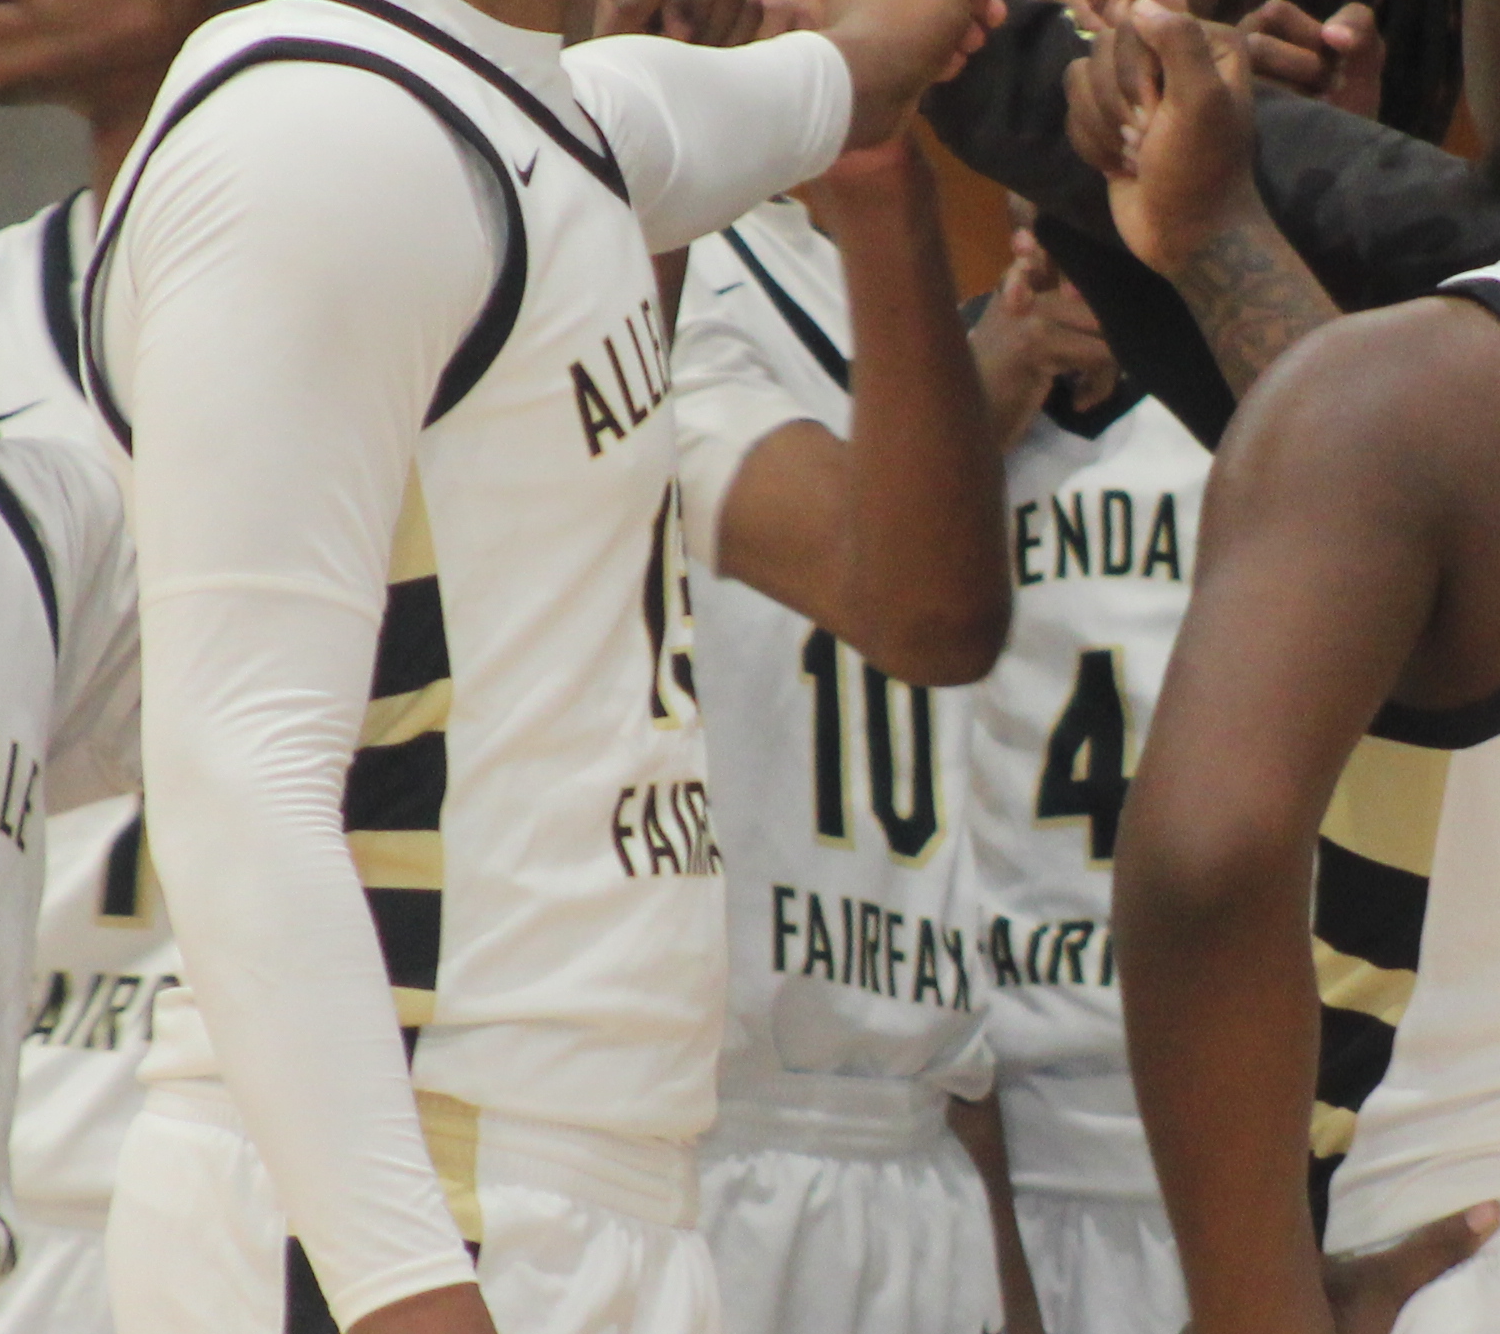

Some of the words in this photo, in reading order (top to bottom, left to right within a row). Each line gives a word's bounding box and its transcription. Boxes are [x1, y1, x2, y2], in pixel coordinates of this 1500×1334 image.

[566, 298, 672, 459] ALLE
[1014, 488, 1182, 588] ENDA
[800, 627, 947, 867] 10
[1031, 645, 1140, 870] 4
[771, 884, 971, 1013] FAIRFAX
